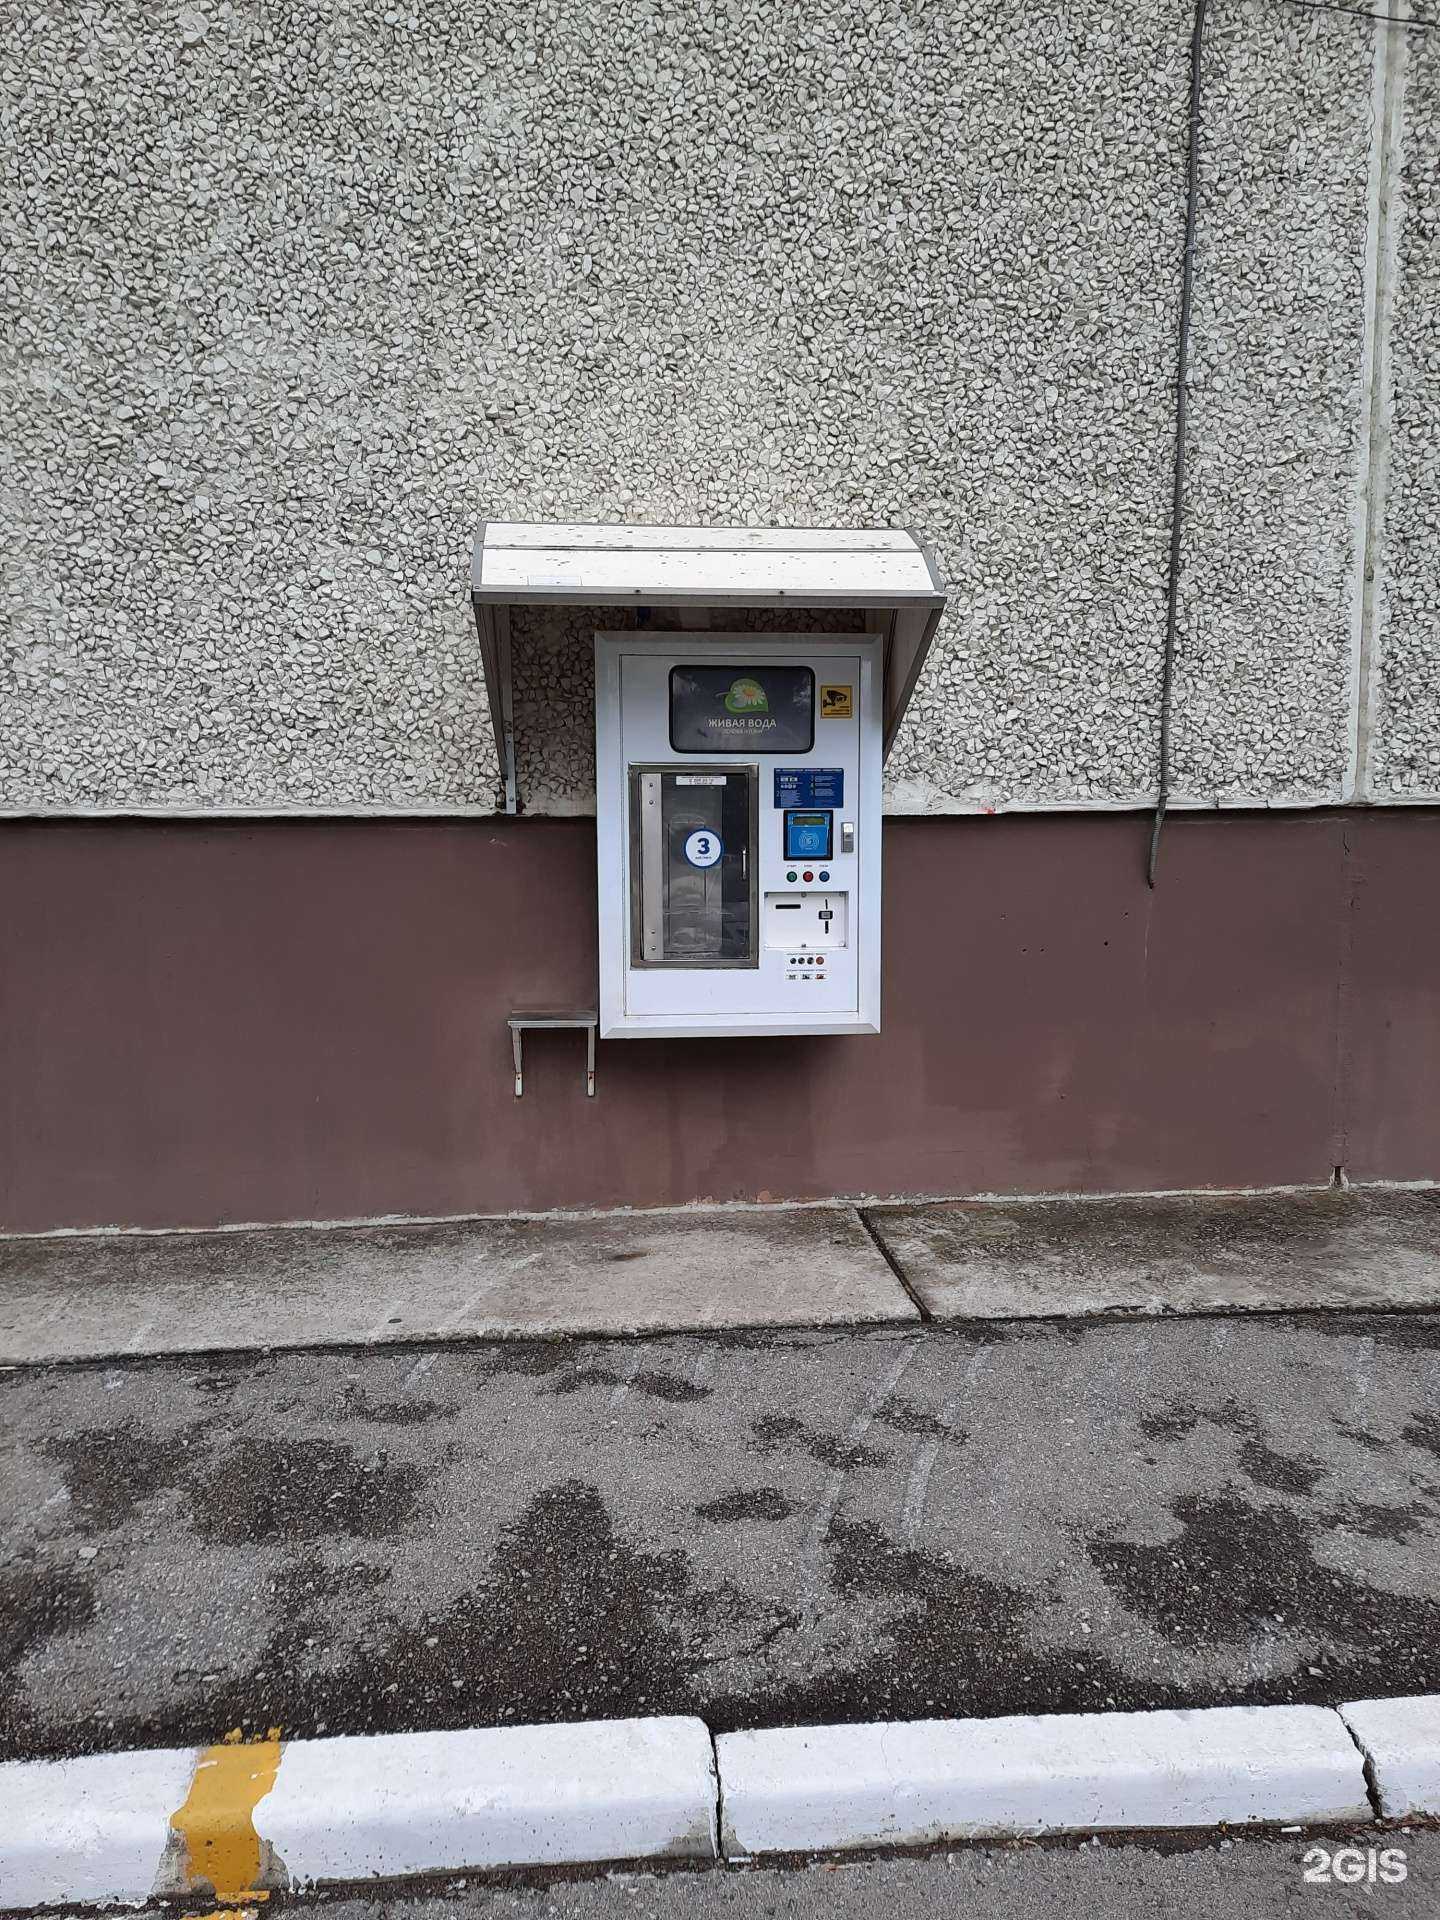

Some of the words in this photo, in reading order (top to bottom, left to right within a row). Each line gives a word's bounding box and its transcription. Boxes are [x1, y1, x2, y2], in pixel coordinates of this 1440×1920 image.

[708, 719, 745, 728] ЖИВАЯ
[748, 719, 777, 729] ВОДА
[697, 837, 710, 855] 3
